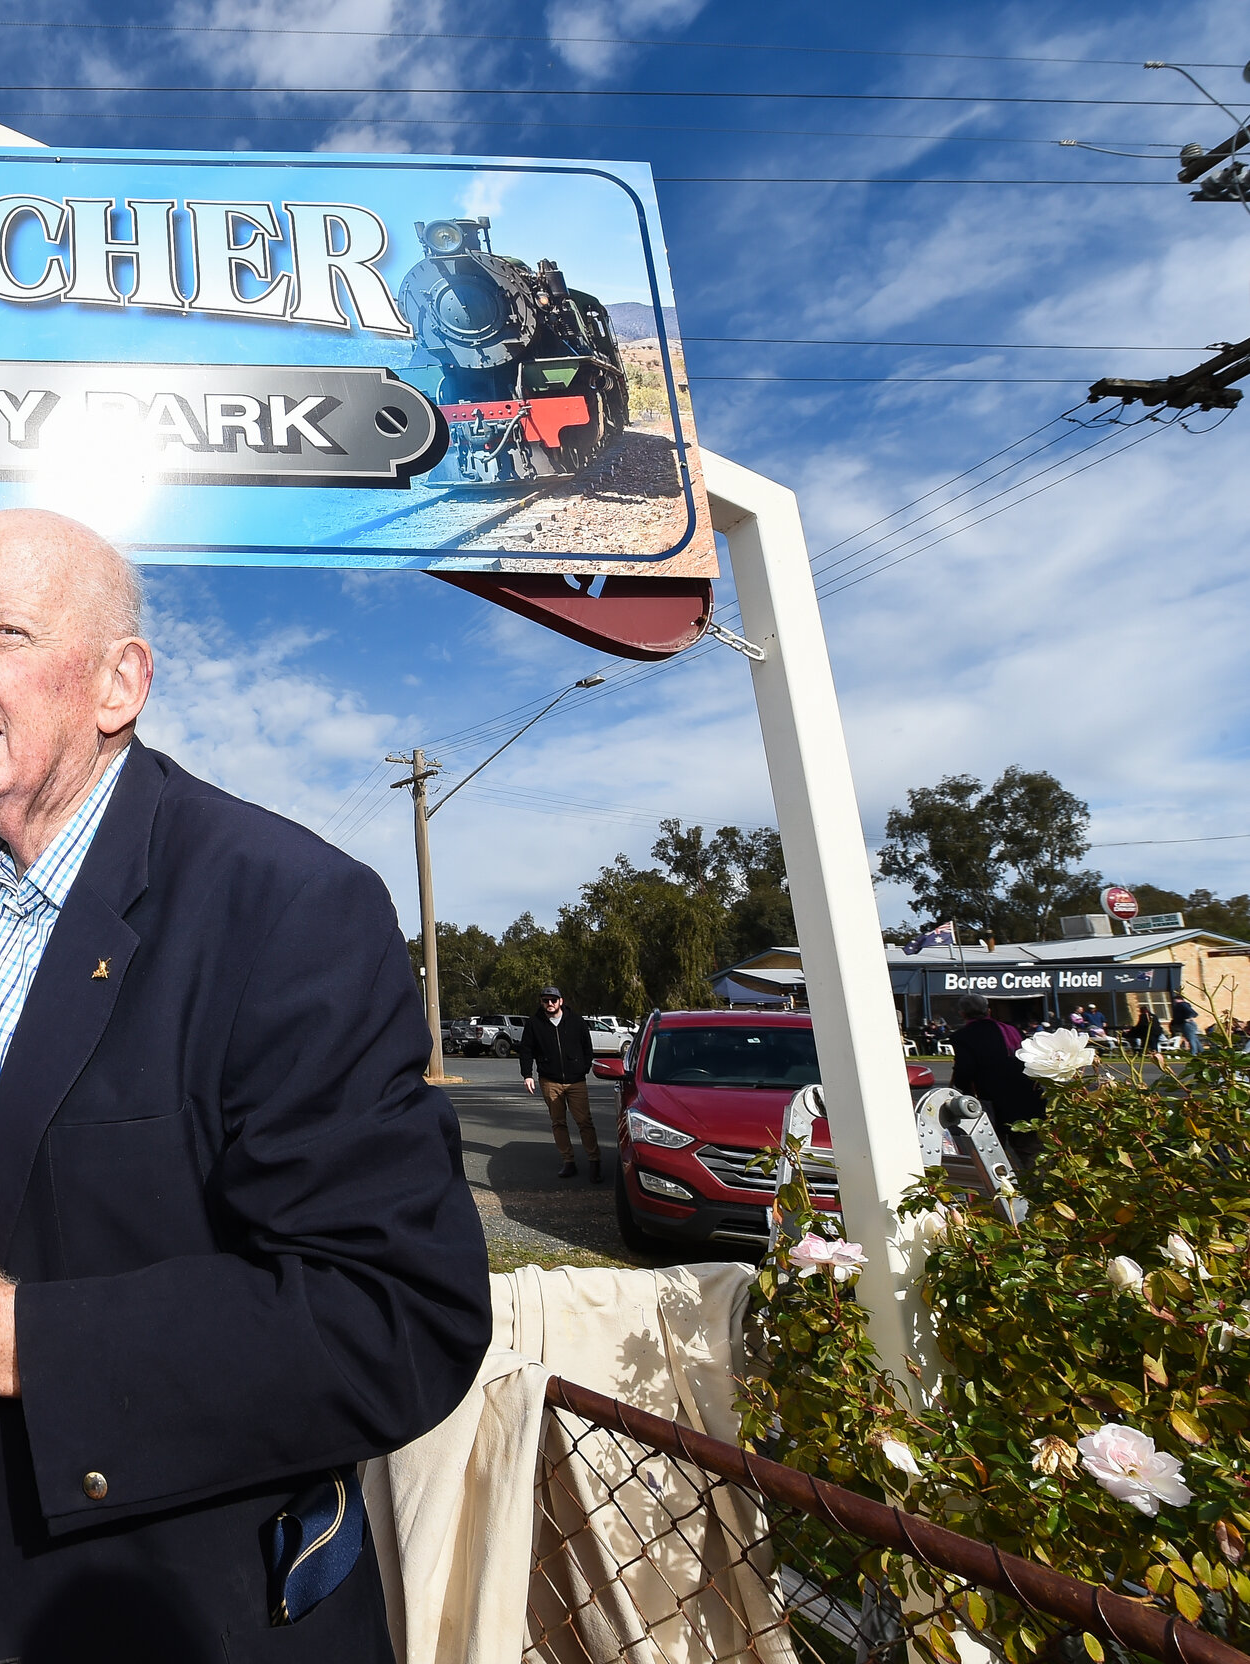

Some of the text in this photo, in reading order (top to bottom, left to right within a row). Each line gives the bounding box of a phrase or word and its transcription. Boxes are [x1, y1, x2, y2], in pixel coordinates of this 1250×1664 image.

[945, 973, 998, 990] Boree
[1002, 971, 1052, 989] Creek
[1059, 970, 1103, 988] Hotel
